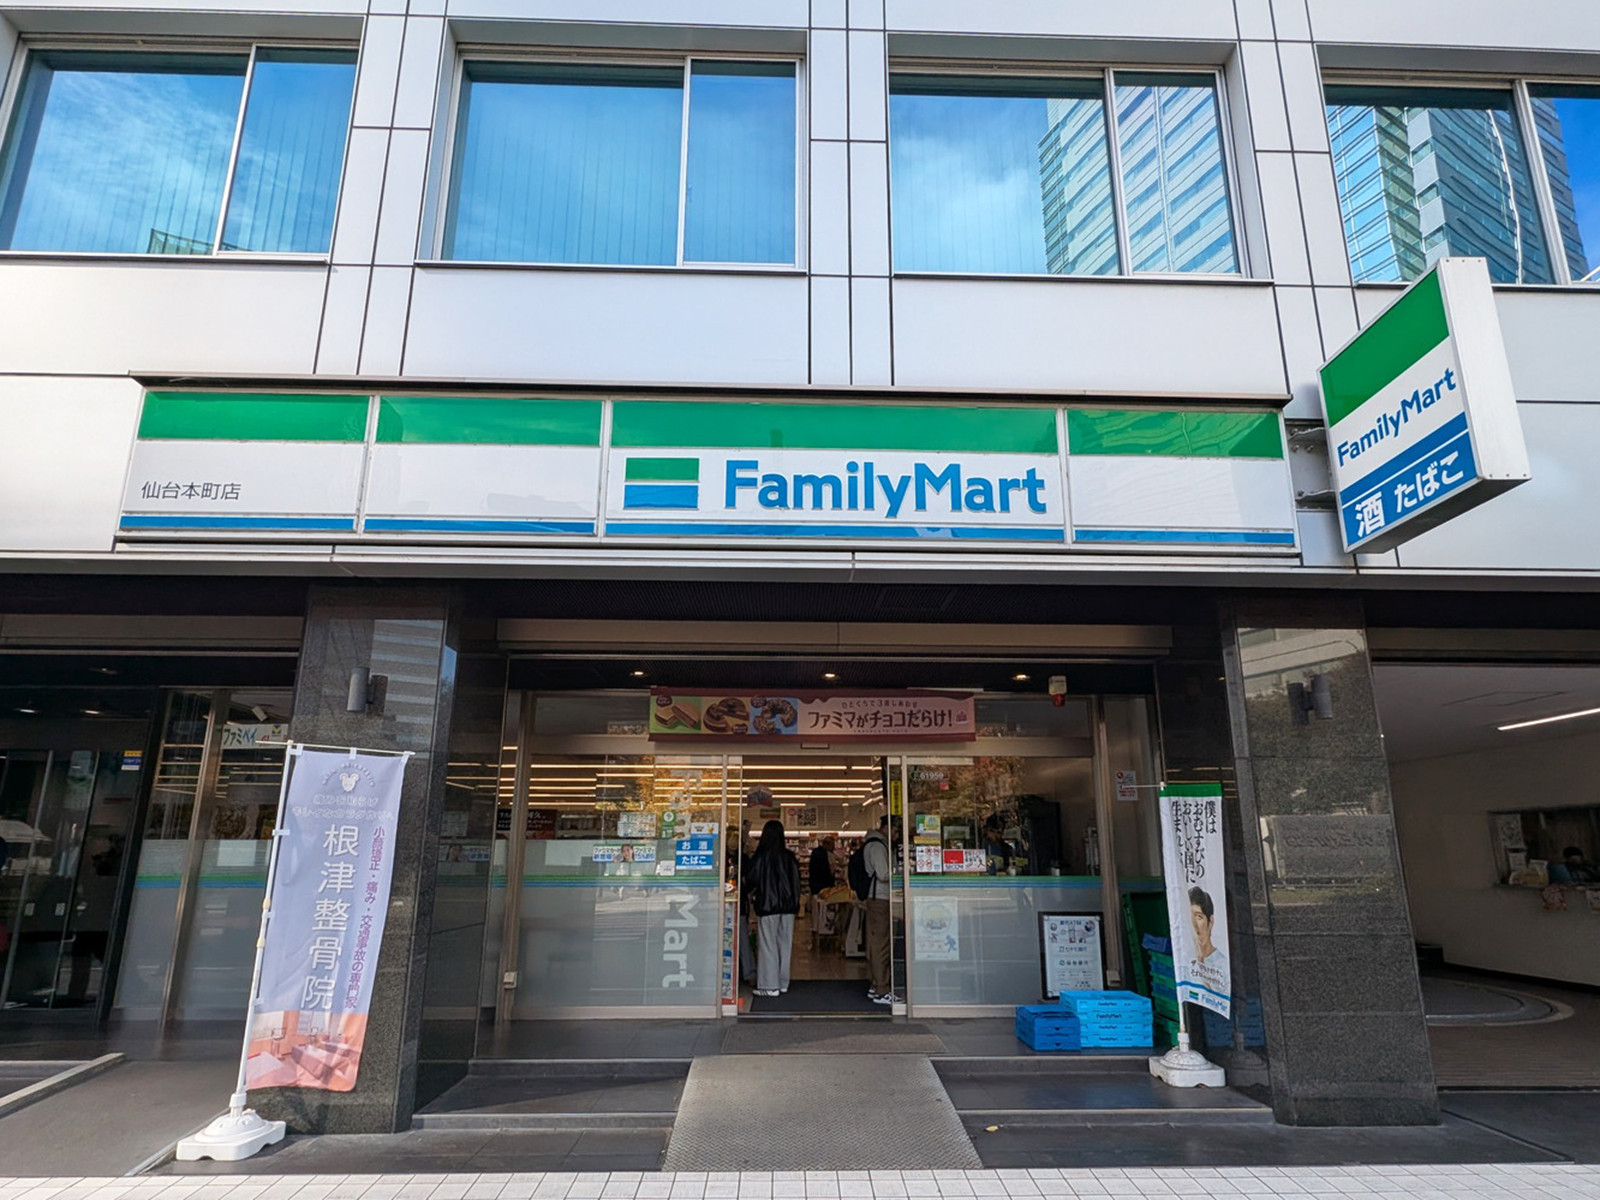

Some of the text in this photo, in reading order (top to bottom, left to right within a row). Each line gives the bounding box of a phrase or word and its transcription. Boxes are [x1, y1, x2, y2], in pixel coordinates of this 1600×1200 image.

[1337, 367, 1456, 468] FamilyMart
[141, 480, 242, 502] 仙台本町店
[724, 459, 1047, 519] FamilyMart
[1355, 450, 1464, 537] 酒 たばこ
[1182, 800, 1196, 884] おいしい国に
[1193, 800, 1205, 879] おむすびの
[1204, 800, 1217, 834] 僕は
[300, 823, 360, 1010] 根津整骨院
